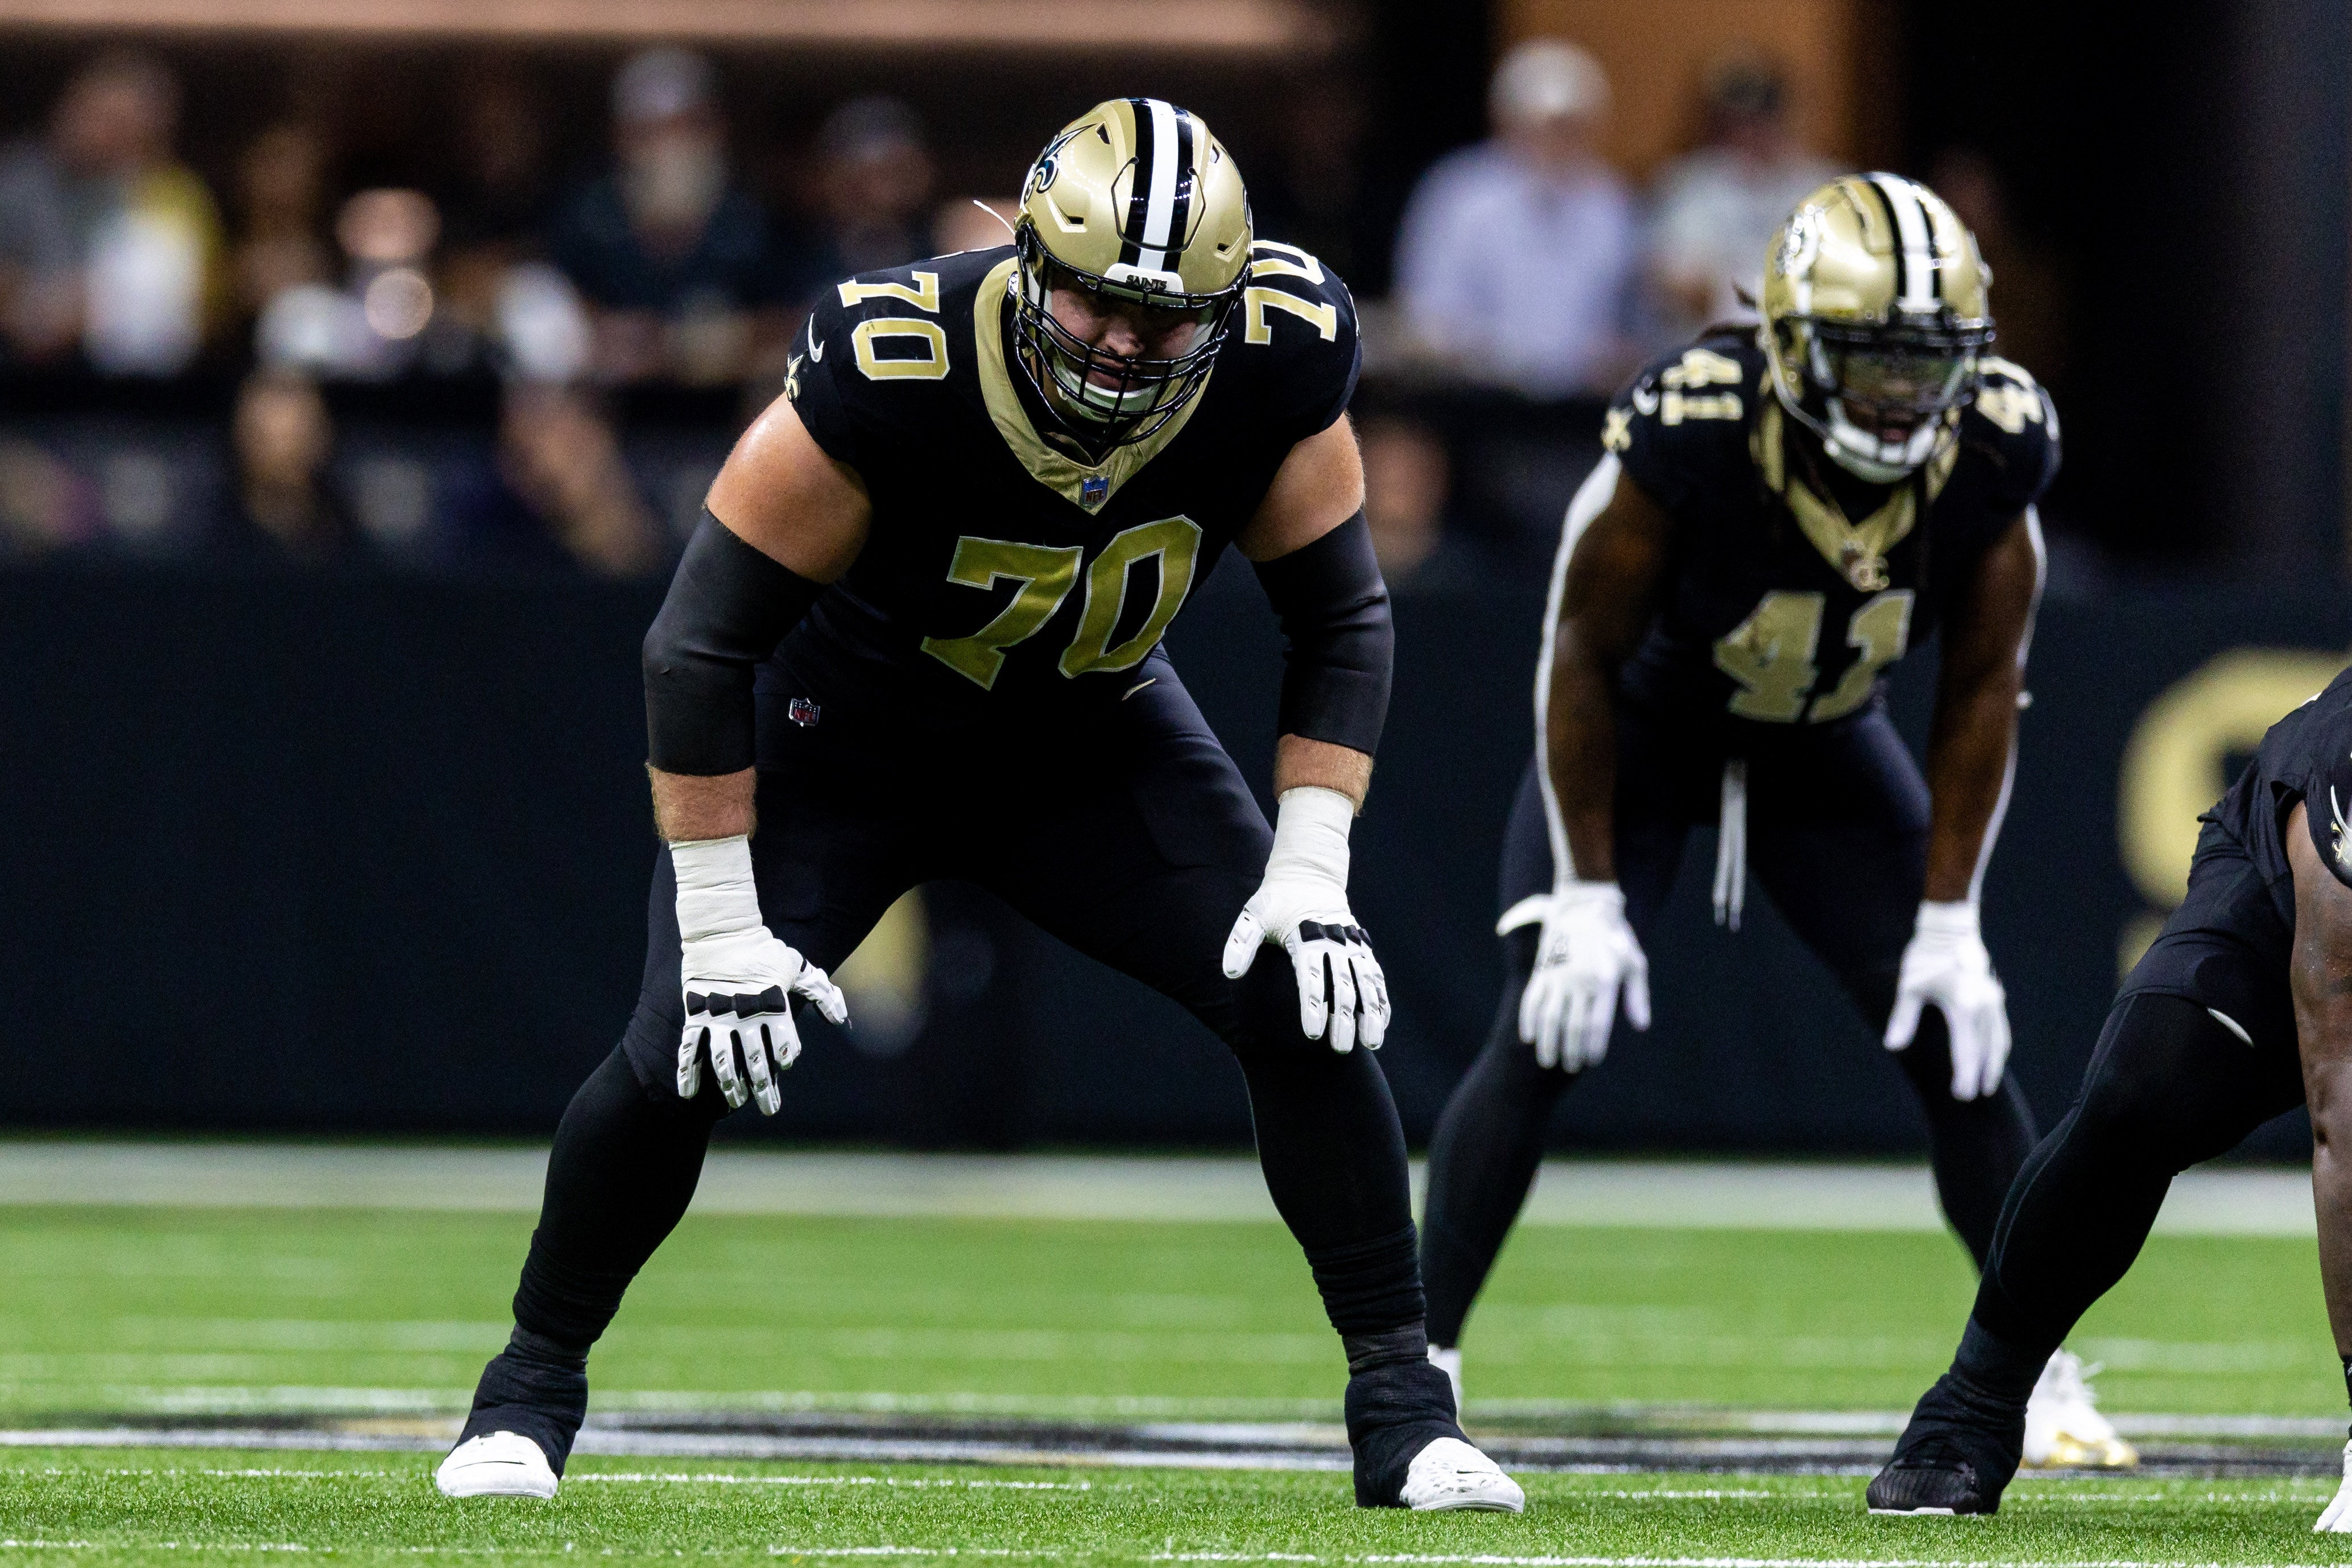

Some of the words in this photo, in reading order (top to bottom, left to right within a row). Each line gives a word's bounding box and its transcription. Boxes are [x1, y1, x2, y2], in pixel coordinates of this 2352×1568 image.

[838, 271, 950, 380] 70
[1126, 274, 1168, 291] SAINTS
[1244, 239, 1337, 346] 70
[1660, 347, 1744, 426] 41
[920, 514, 1203, 692] 70
[1713, 589, 1916, 725] 41
